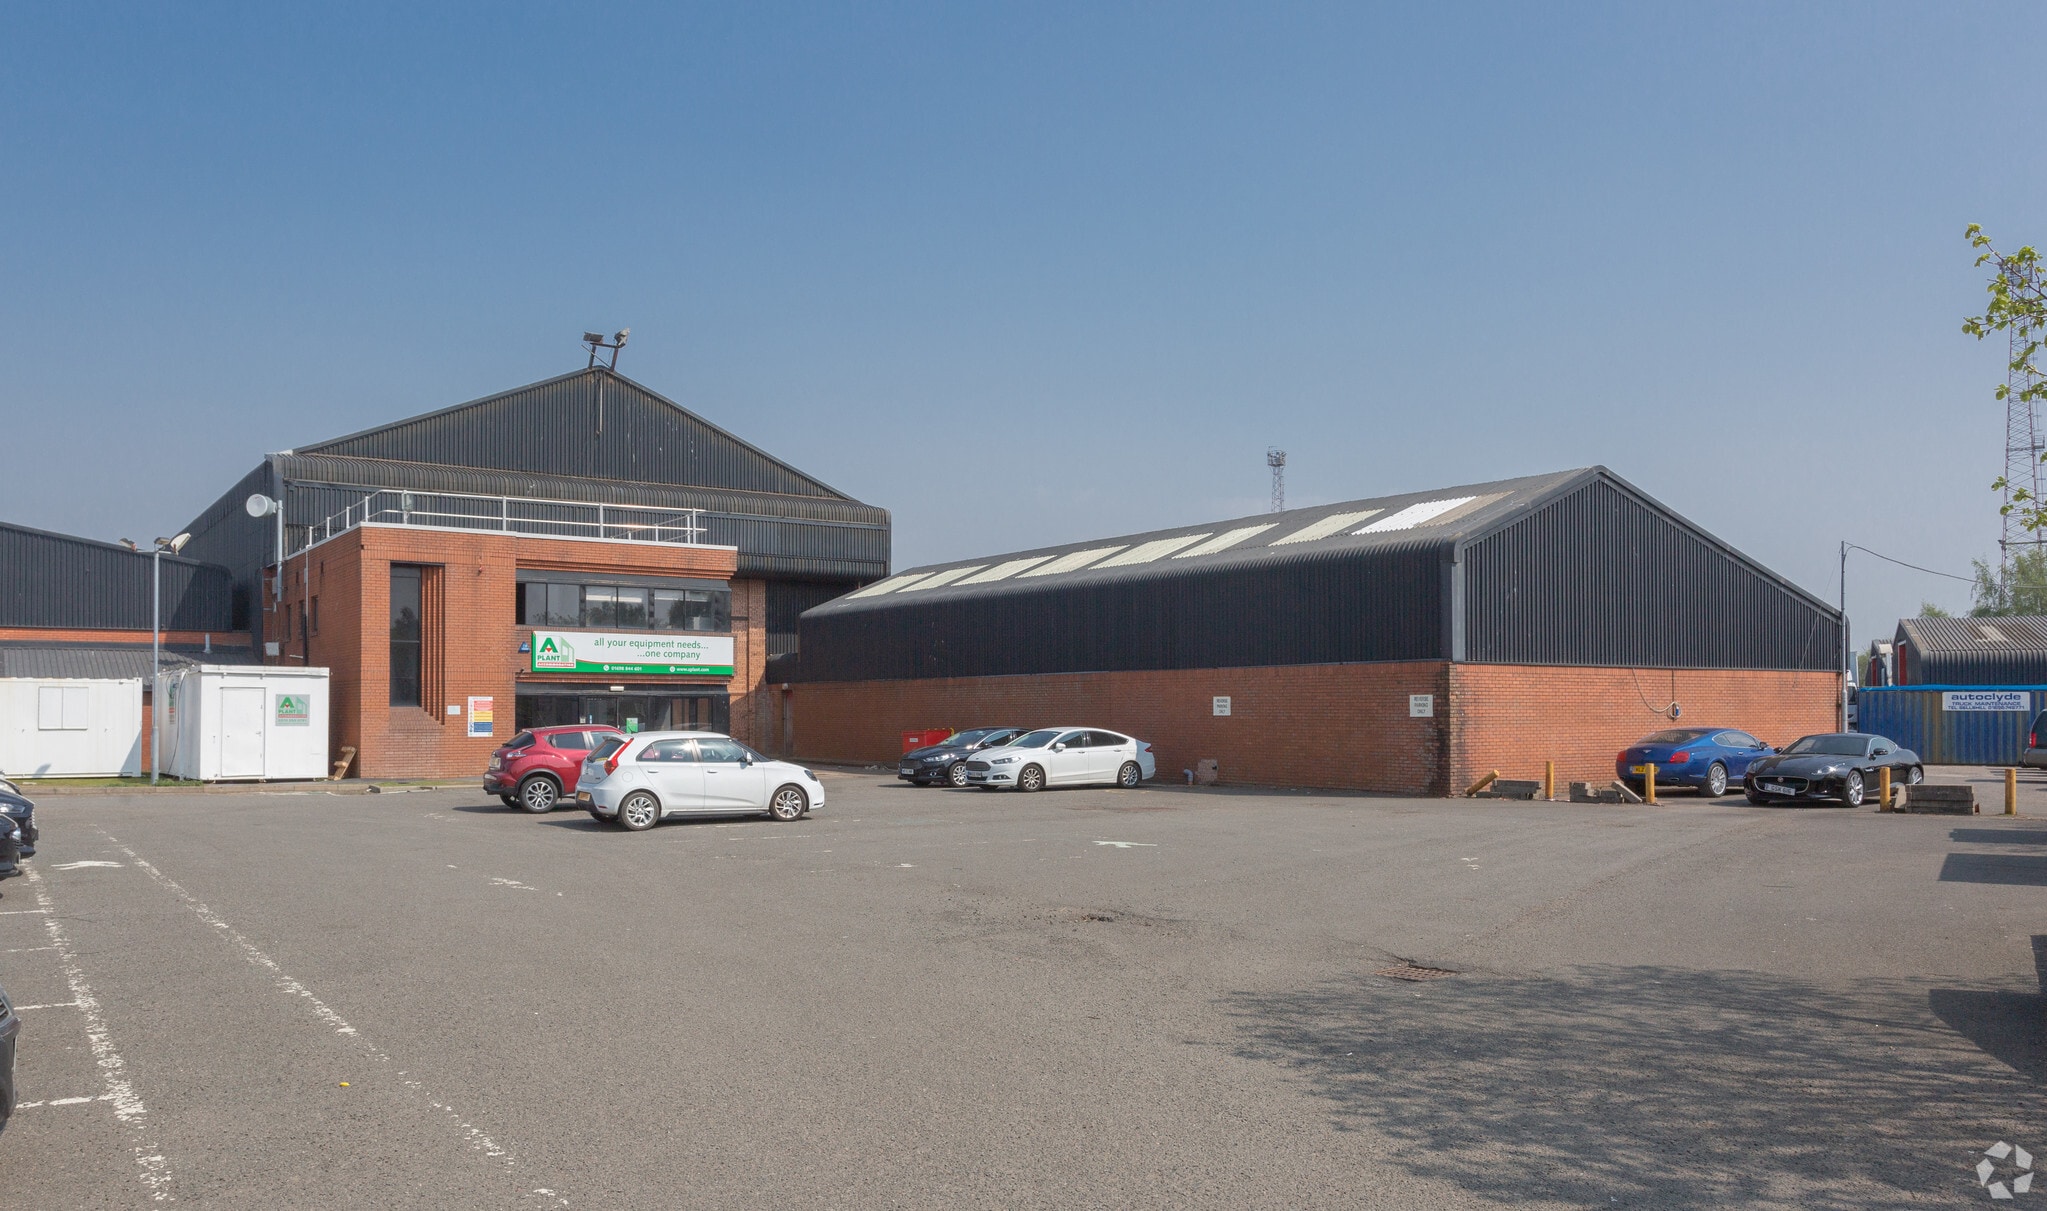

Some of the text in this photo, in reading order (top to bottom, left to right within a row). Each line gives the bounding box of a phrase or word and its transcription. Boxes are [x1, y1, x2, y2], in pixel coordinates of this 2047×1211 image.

[539, 637, 558, 653] A
[594, 637, 709, 649] all your equipment needs...
[637, 650, 701, 661] ...one company
[280, 696, 295, 708] A
[1951, 693, 2021, 702] autoclyde
